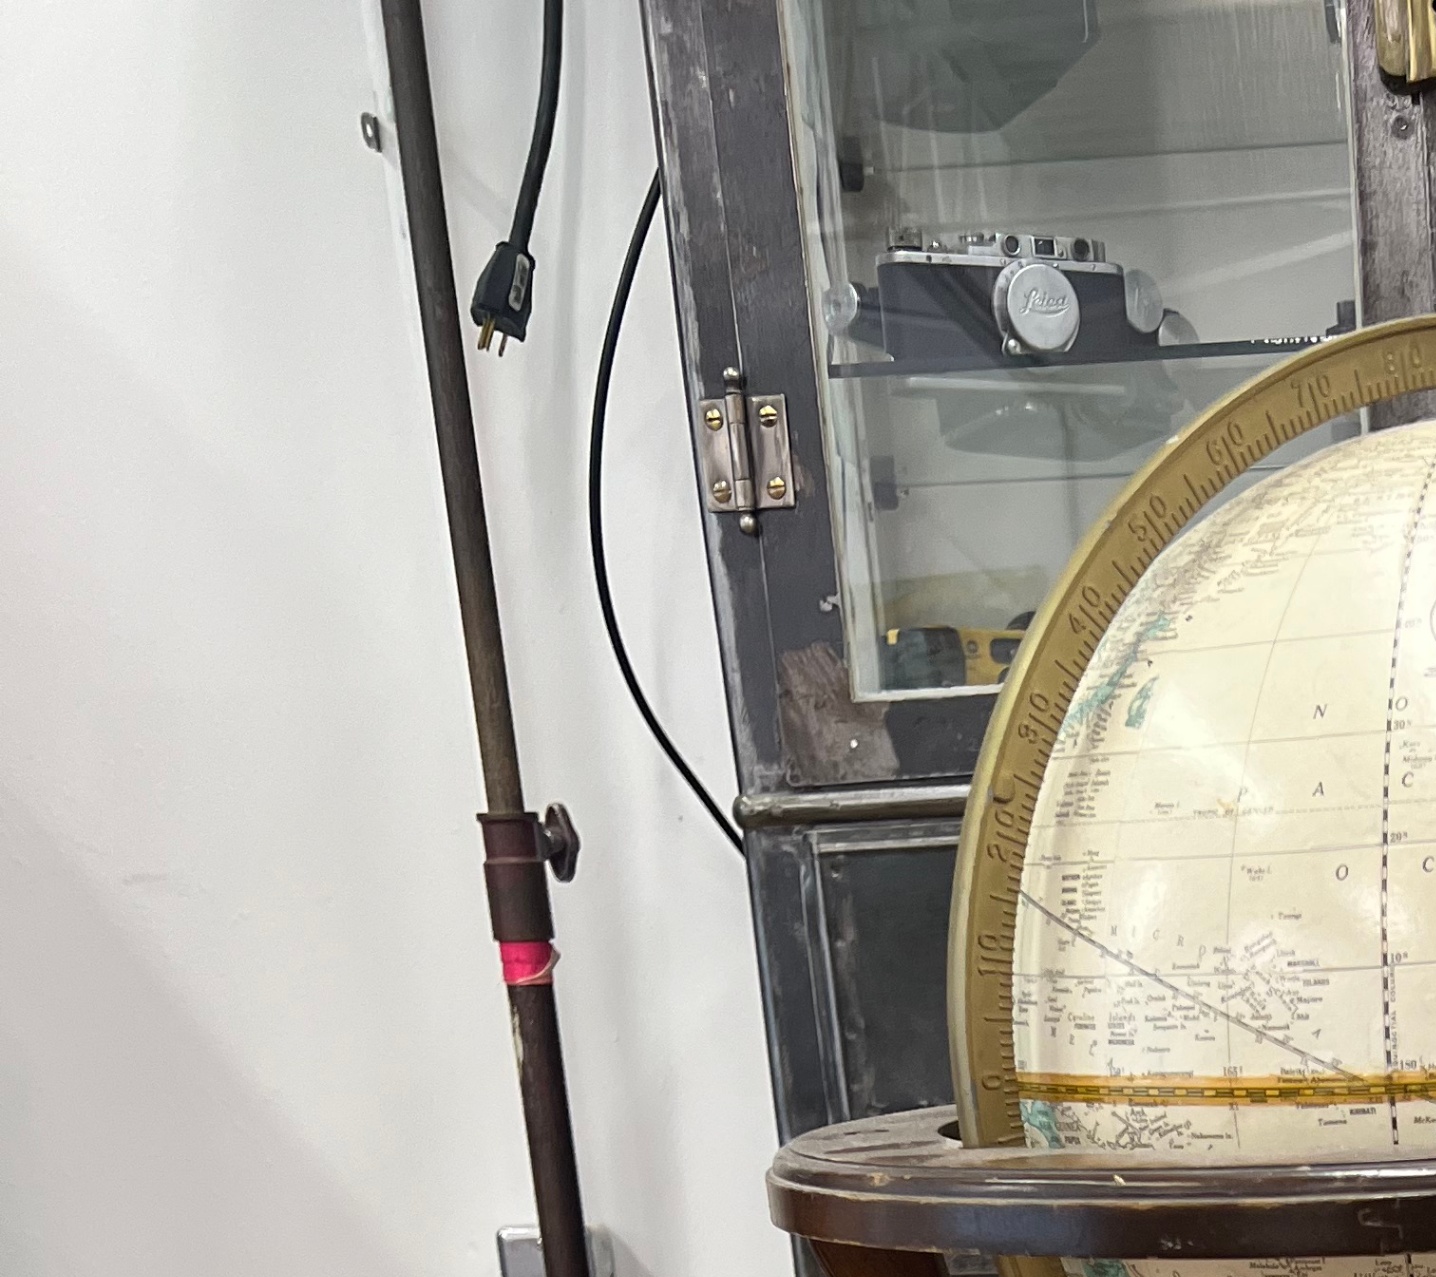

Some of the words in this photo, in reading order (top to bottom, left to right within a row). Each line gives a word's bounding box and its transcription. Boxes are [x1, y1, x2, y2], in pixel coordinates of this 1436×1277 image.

[1020, 287, 1071, 318] Leica
[1206, 421, 1243, 467] 60
[1128, 494, 1166, 543] 50
[1067, 585, 1101, 635] 40
